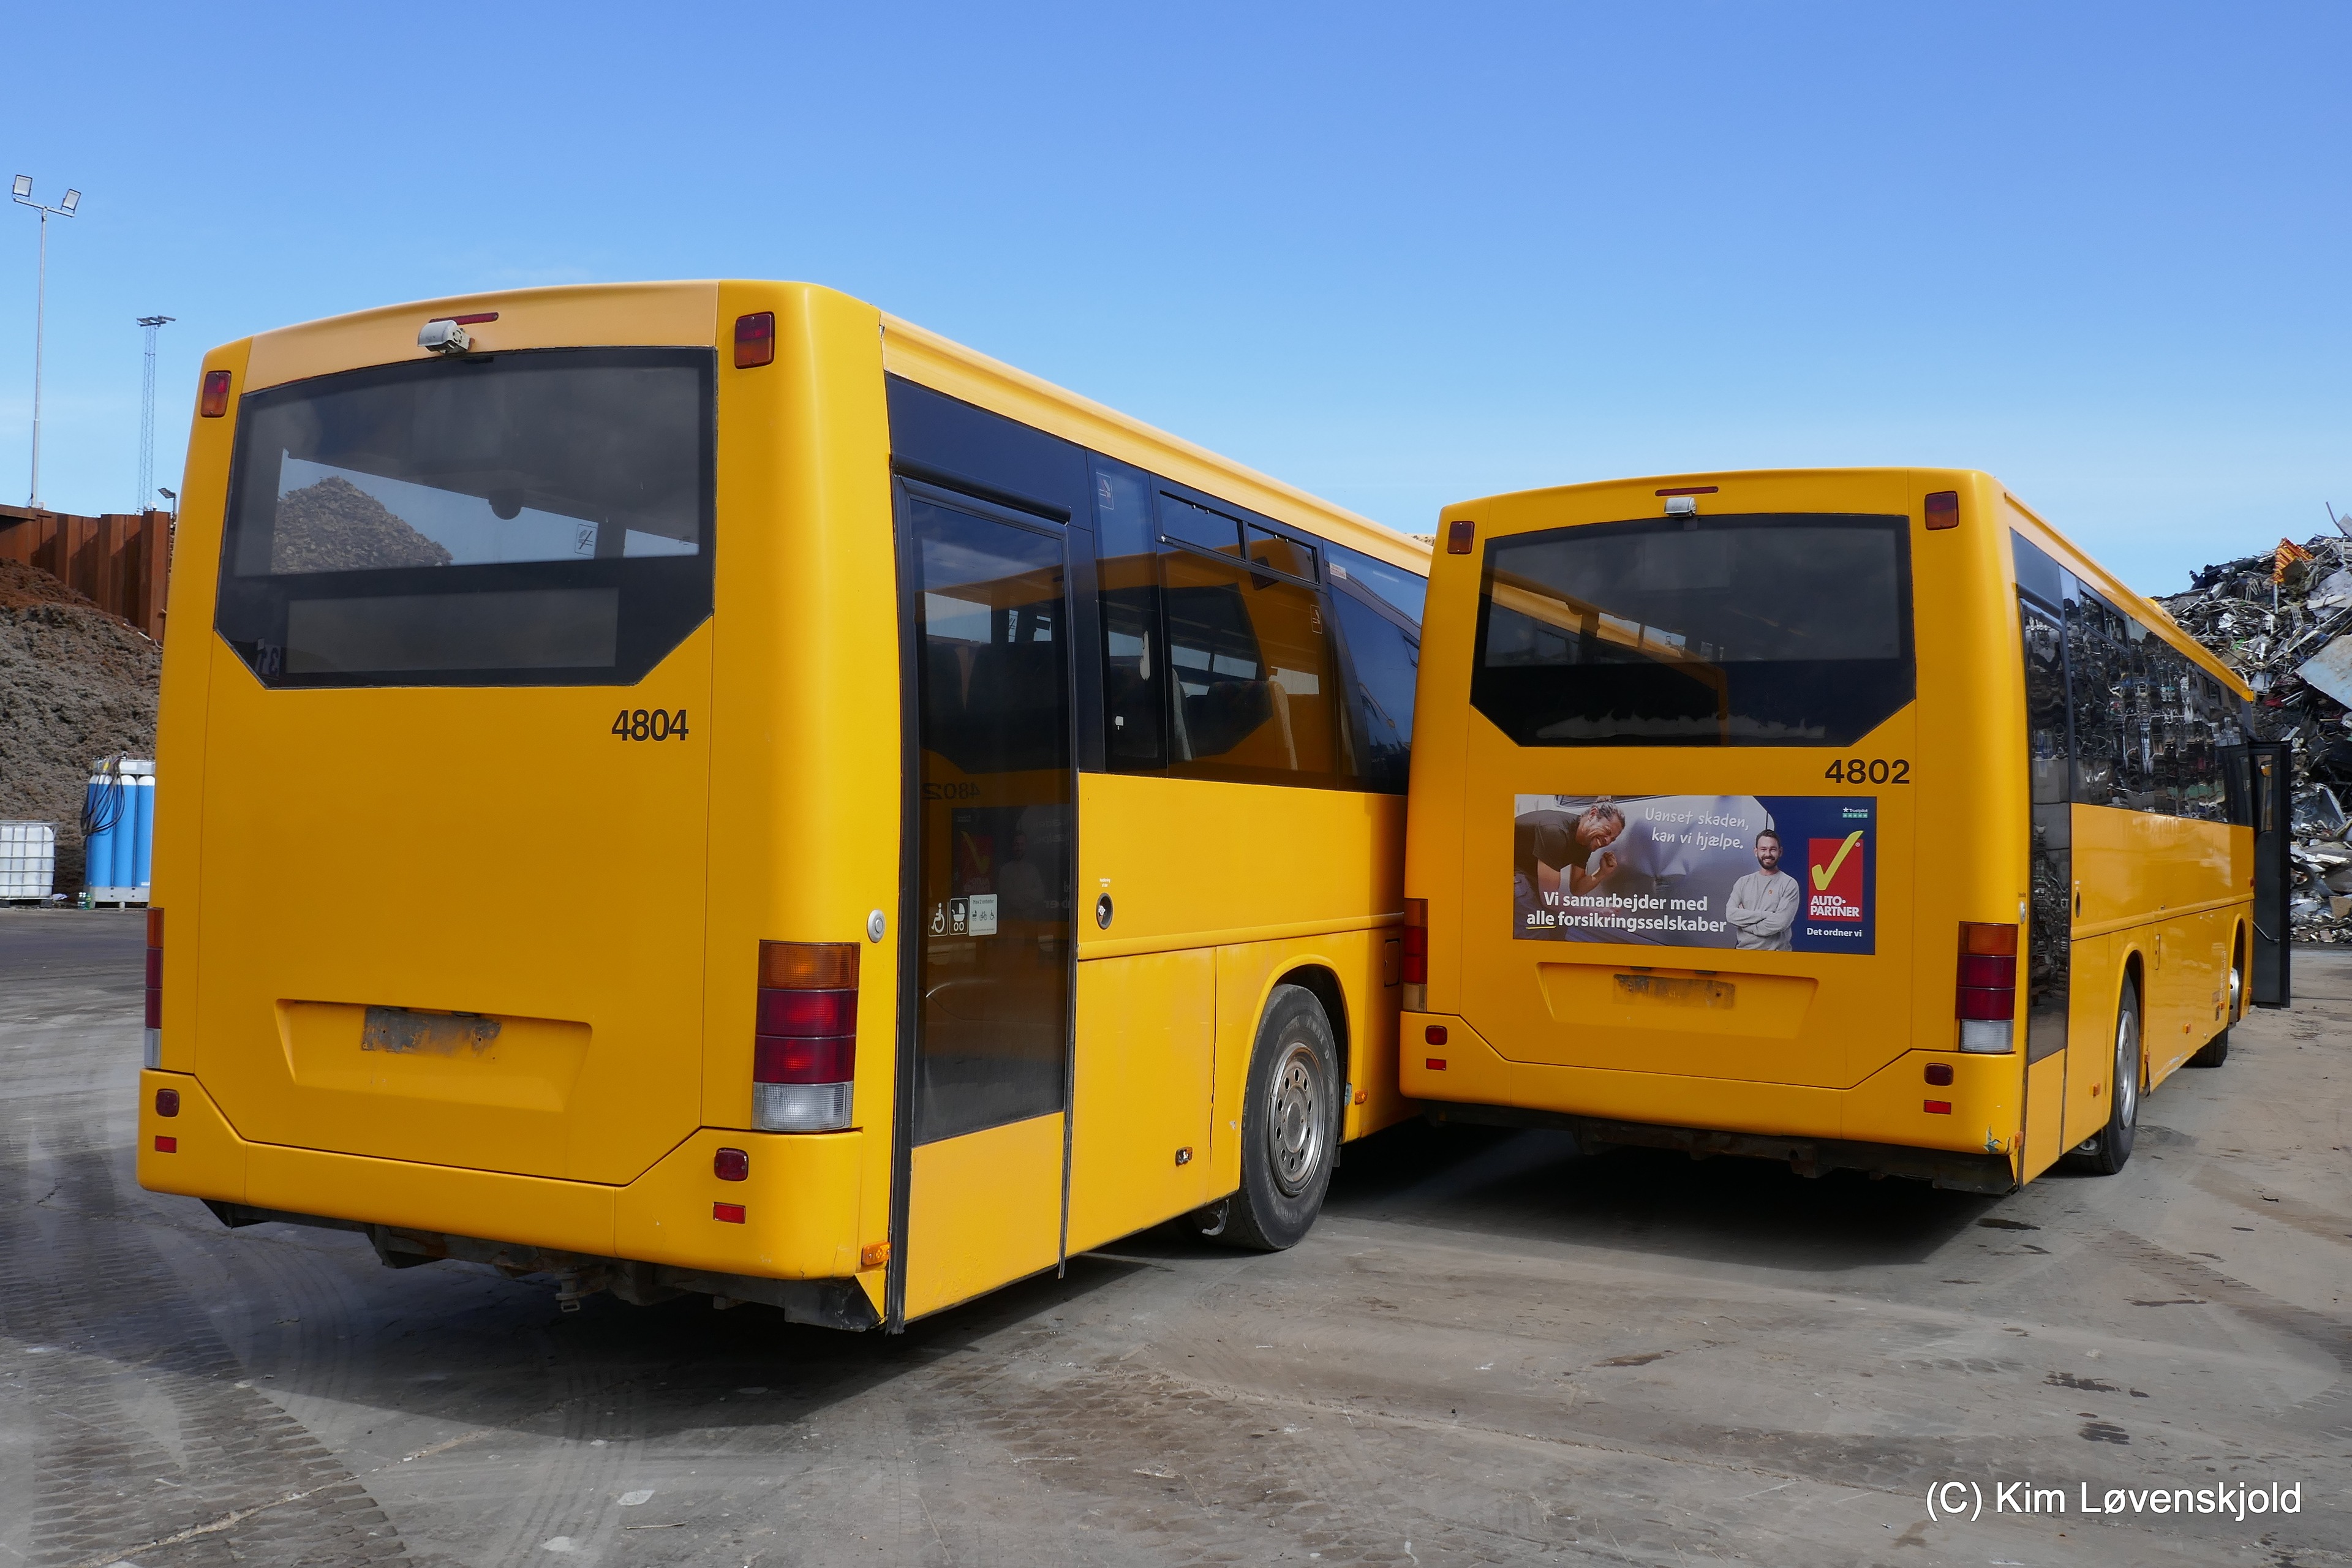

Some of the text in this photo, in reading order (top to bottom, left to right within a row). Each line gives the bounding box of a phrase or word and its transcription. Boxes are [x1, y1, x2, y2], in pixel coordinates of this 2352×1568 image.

[611, 709, 689, 741] 4804
[1825, 759, 1910, 784] 4802
[1645, 808, 1749, 831] Uanset skaden,
[1651, 827, 1744, 851] kan vi hjælpe.
[1544, 891, 1708, 913] Vi samarbejder med
[1810, 906, 1860, 917] PARTNER
[1526, 910, 1727, 932] alle forsikringsselskaber
